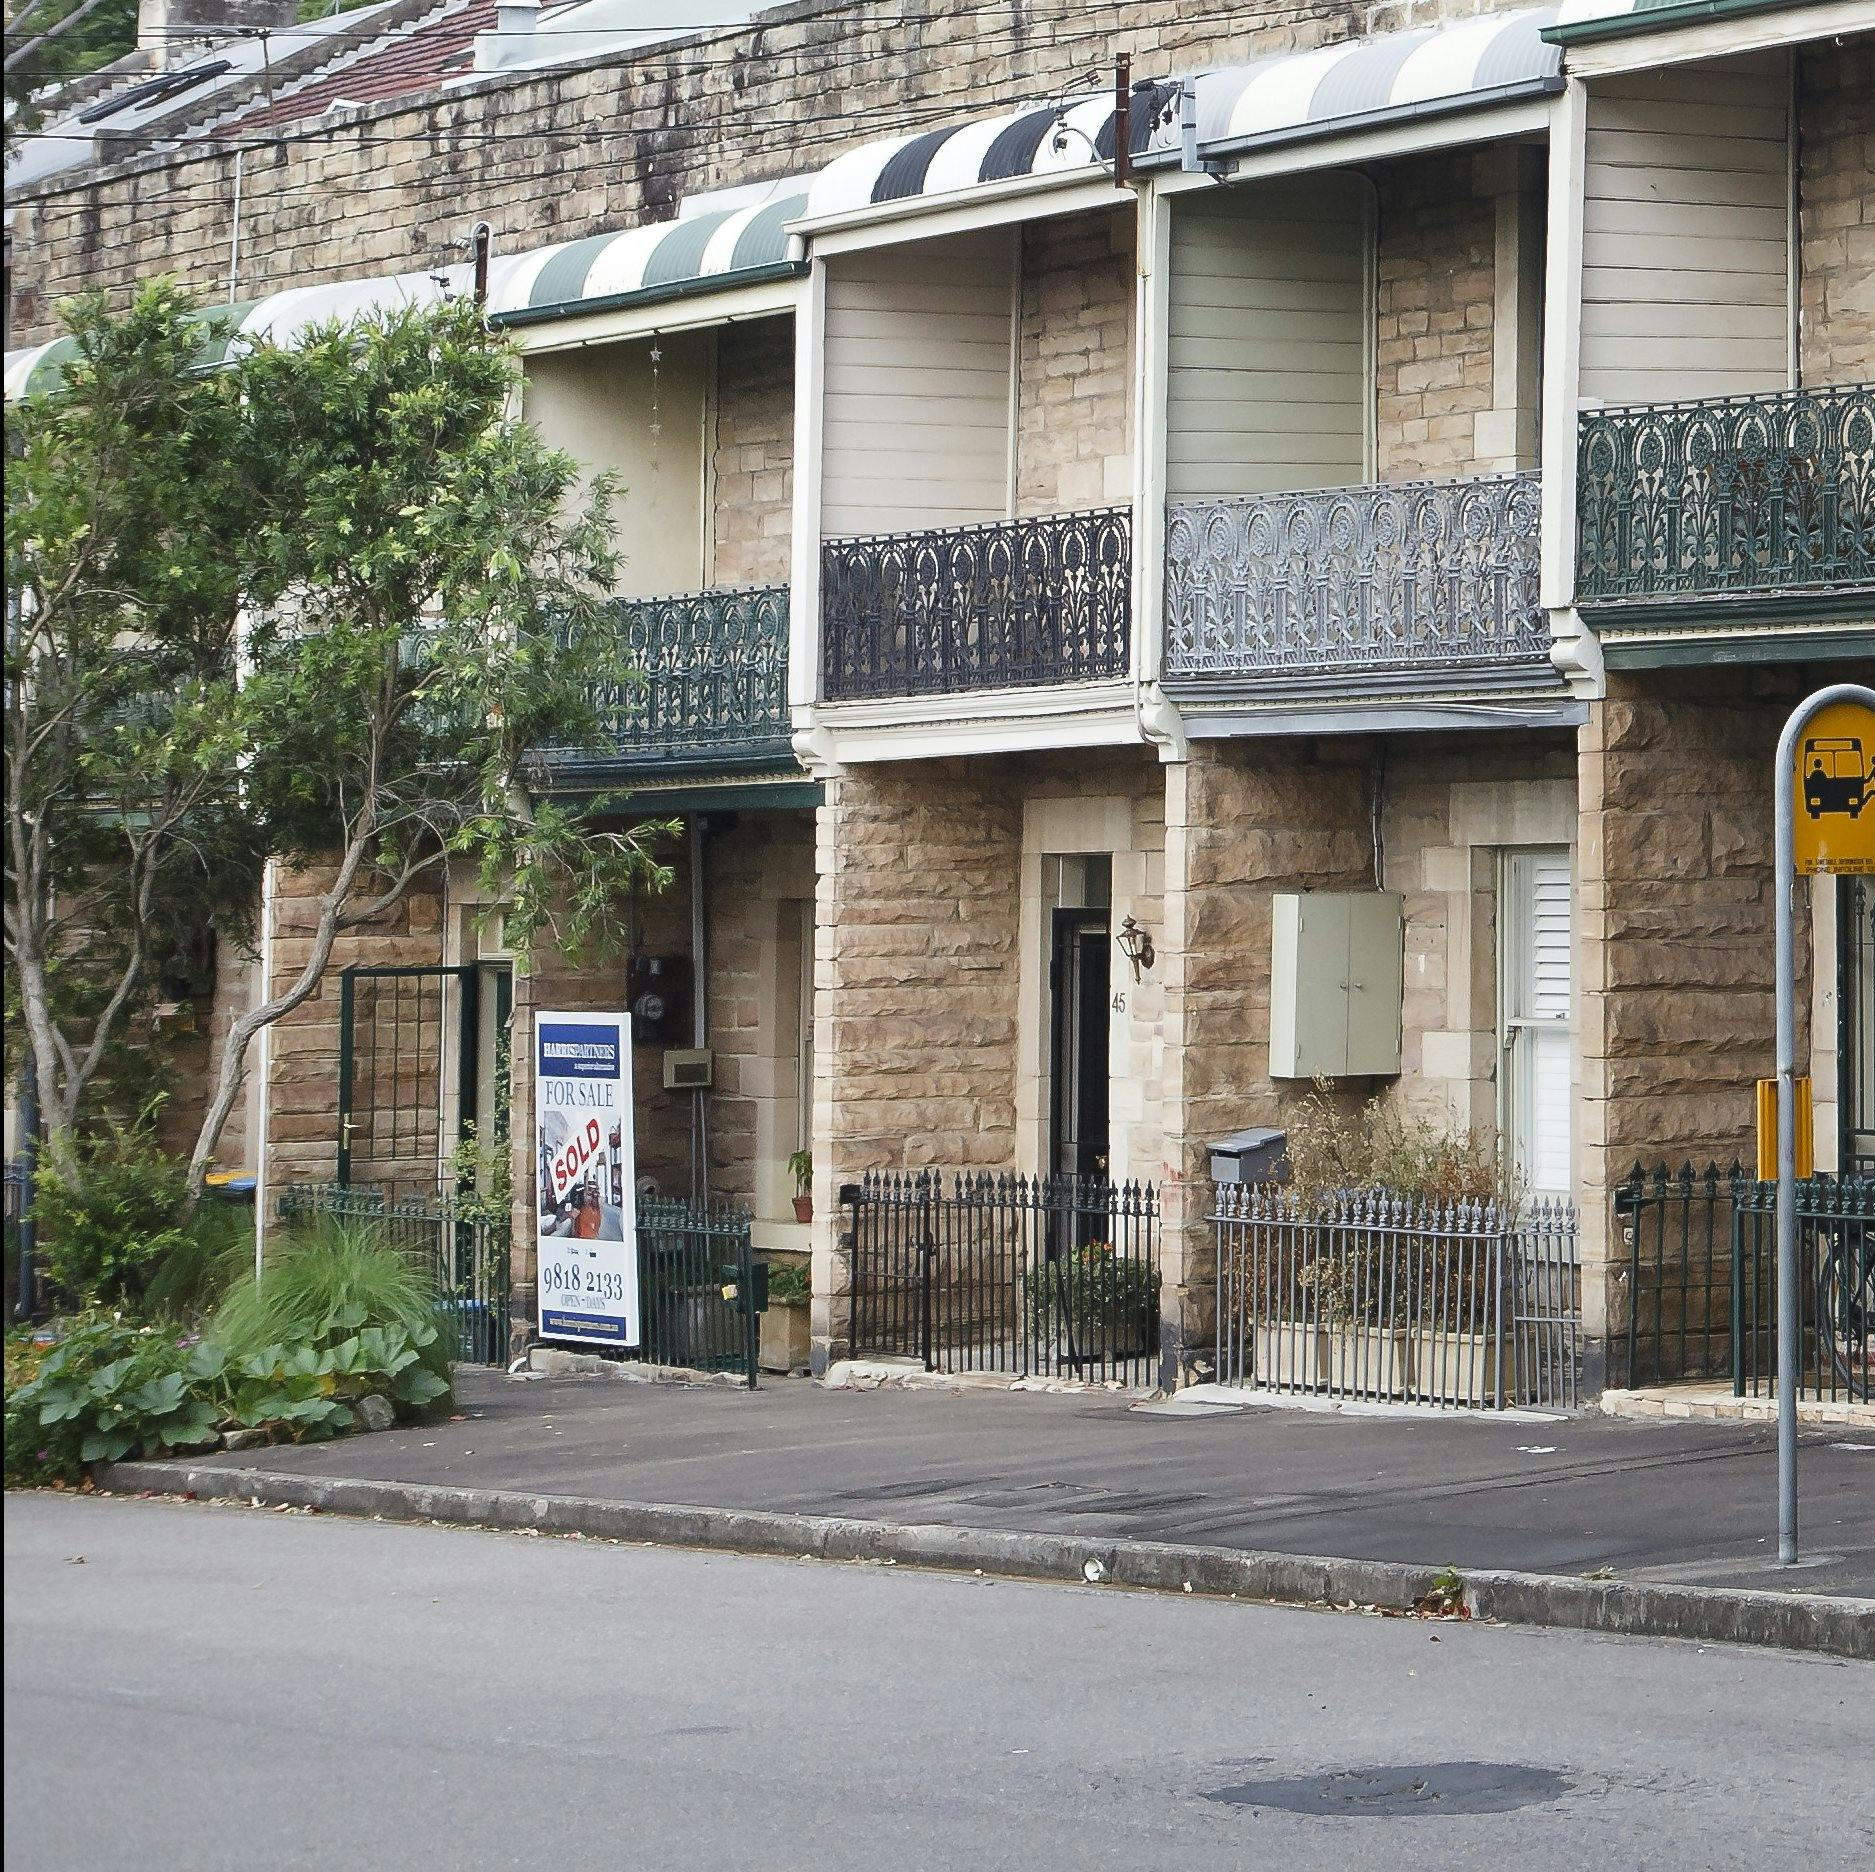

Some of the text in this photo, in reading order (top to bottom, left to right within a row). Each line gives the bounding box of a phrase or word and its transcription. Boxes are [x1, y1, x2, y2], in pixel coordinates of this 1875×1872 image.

[1112, 992, 1126, 1013] 45
[545, 1080, 614, 1107] FOR SALE
[555, 1118, 600, 1192] SOLD
[543, 1262, 623, 1301] 9818 2133
